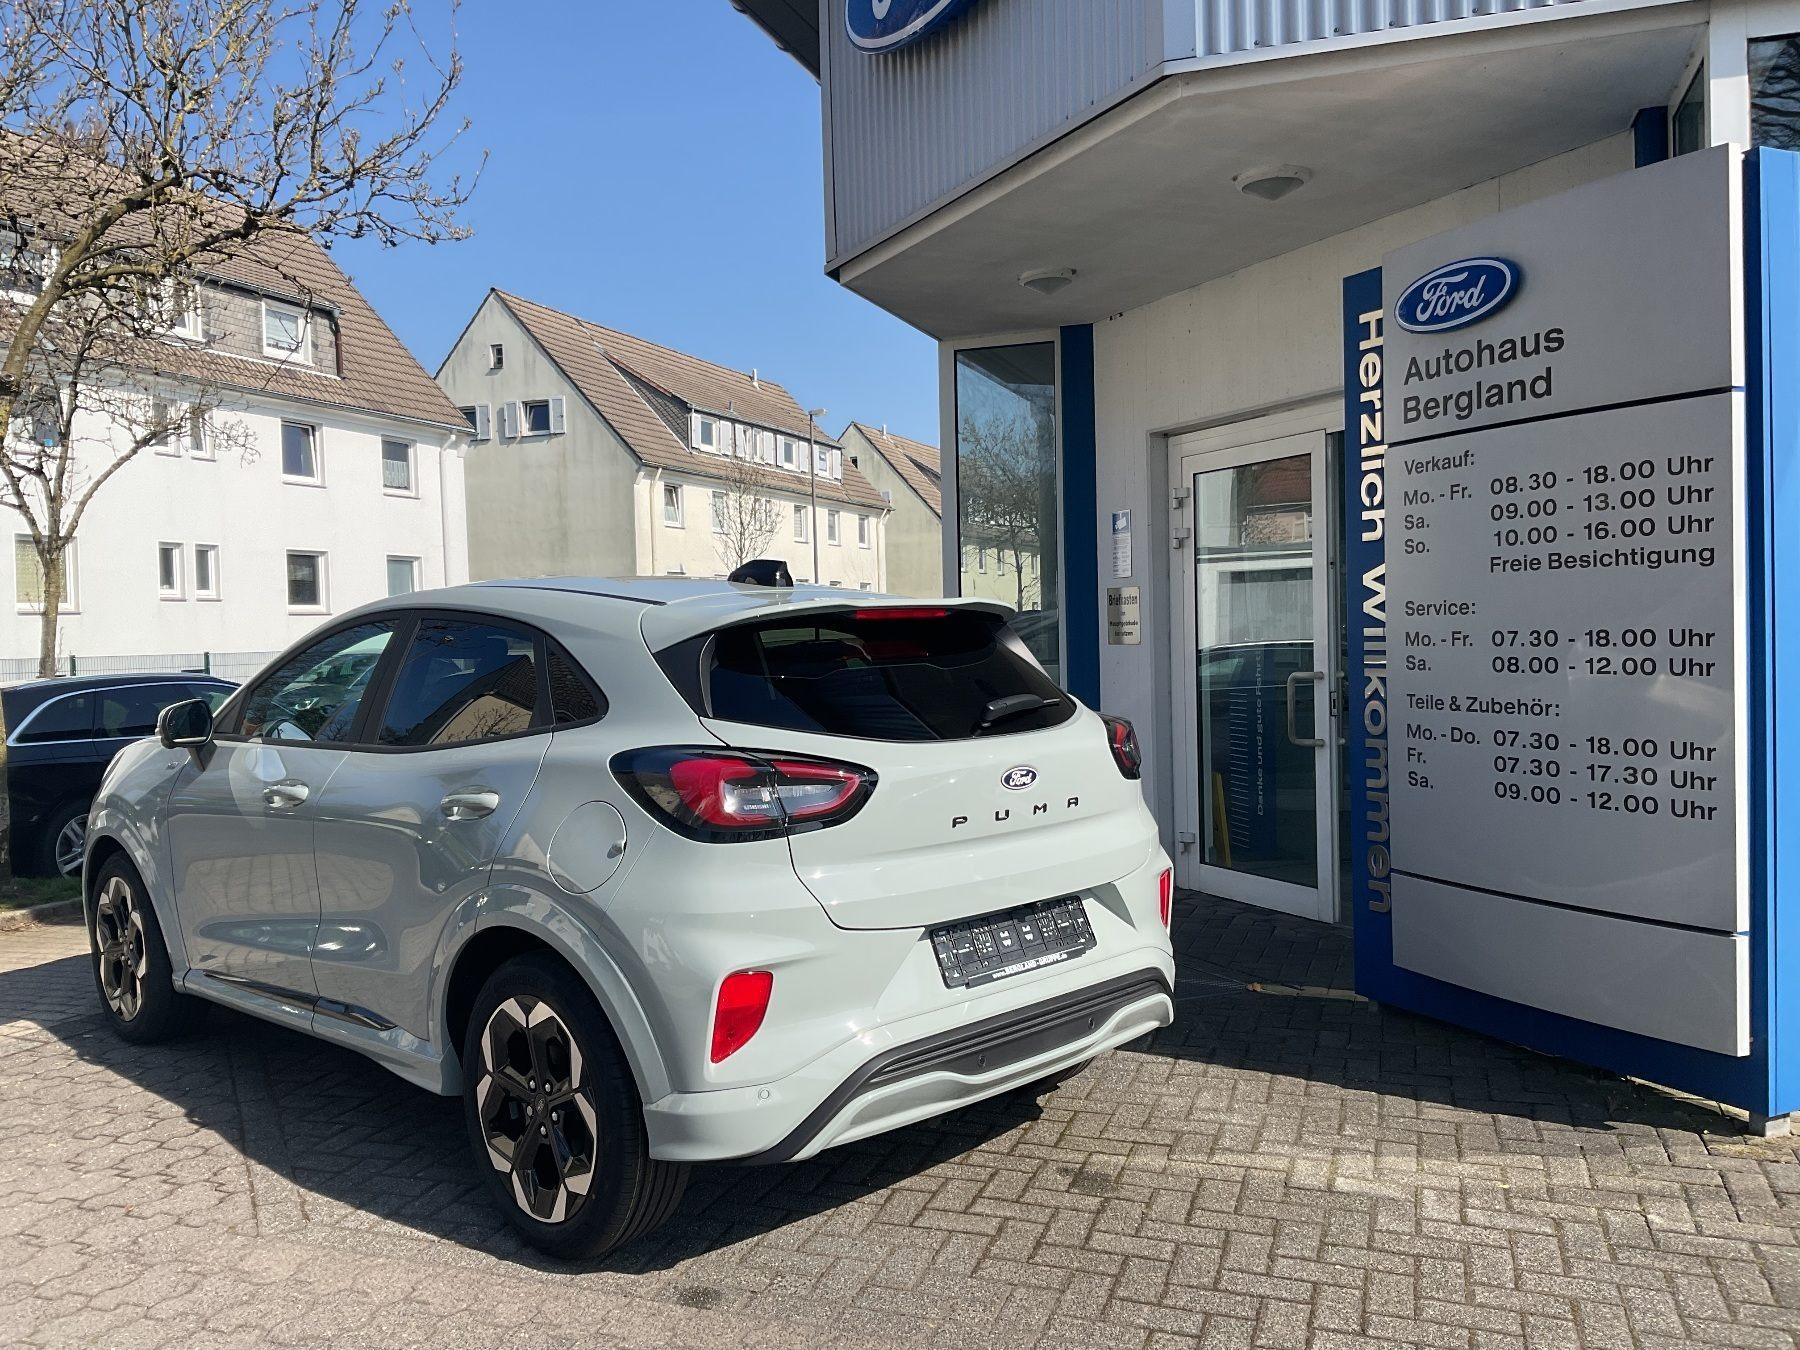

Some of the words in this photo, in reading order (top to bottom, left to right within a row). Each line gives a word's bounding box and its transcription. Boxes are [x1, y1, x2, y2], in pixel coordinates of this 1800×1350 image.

[1403, 327, 1565, 386] Autohaus
[1403, 366, 1553, 425] Bergland
[1358, 308, 1388, 542] Herzlich
[1403, 449, 1475, 476] Verkauf:
[1449, 484, 1472, 501] Fr.
[1490, 471, 1557, 496] 08.30
[1582, 460, 1655, 486] 18.00
[1667, 455, 1715, 476] Uhr
[1404, 514, 1431, 531] Sa.
[1490, 499, 1558, 522] 09.00
[1582, 489, 1656, 514] 13.00
[1667, 485, 1715, 506] Uhr
[1404, 538, 1431, 555] So.
[1493, 526, 1558, 548] 10.00
[1583, 518, 1656, 541] 16.00
[1667, 515, 1715, 535] Uhr
[1489, 553, 1542, 574] Freie
[1547, 546, 1715, 571] Besichtigung
[1404, 600, 1476, 617] Service:
[1451, 630, 1474, 647] Fr.
[1491, 629, 1559, 648] 07.30
[1584, 628, 1657, 648] 18.00
[1668, 628, 1716, 648] Uhr
[1405, 654, 1432, 672] Sa.
[1491, 655, 1559, 675] 08.00
[1584, 656, 1657, 677] 12.00
[1668, 657, 1716, 678] Uhr
[1405, 693, 1445, 712] Teile
[1448, 695, 1462, 712] &
[1465, 695, 1560, 718] Zubehör:
[1255, 735, 1264, 765] und
[1362, 563, 1392, 912] Willkommen
[1493, 729, 1560, 751] 07.30
[1585, 735, 1658, 757] 18.00
[1669, 740, 1717, 762] Uhr
[1407, 746, 1427, 764] Fr.
[1493, 755, 1561, 778] 07.30
[1586, 763, 1658, 787] 17.30
[1670, 769, 1718, 792] Uhr
[1255, 768, 1265, 816] Danke
[1408, 770, 1434, 790] Sa.
[1494, 781, 1561, 805] 09.00
[1586, 791, 1659, 815] 12.00
[1670, 798, 1718, 821] Uhr
[951, 796, 1080, 829] PUMA
